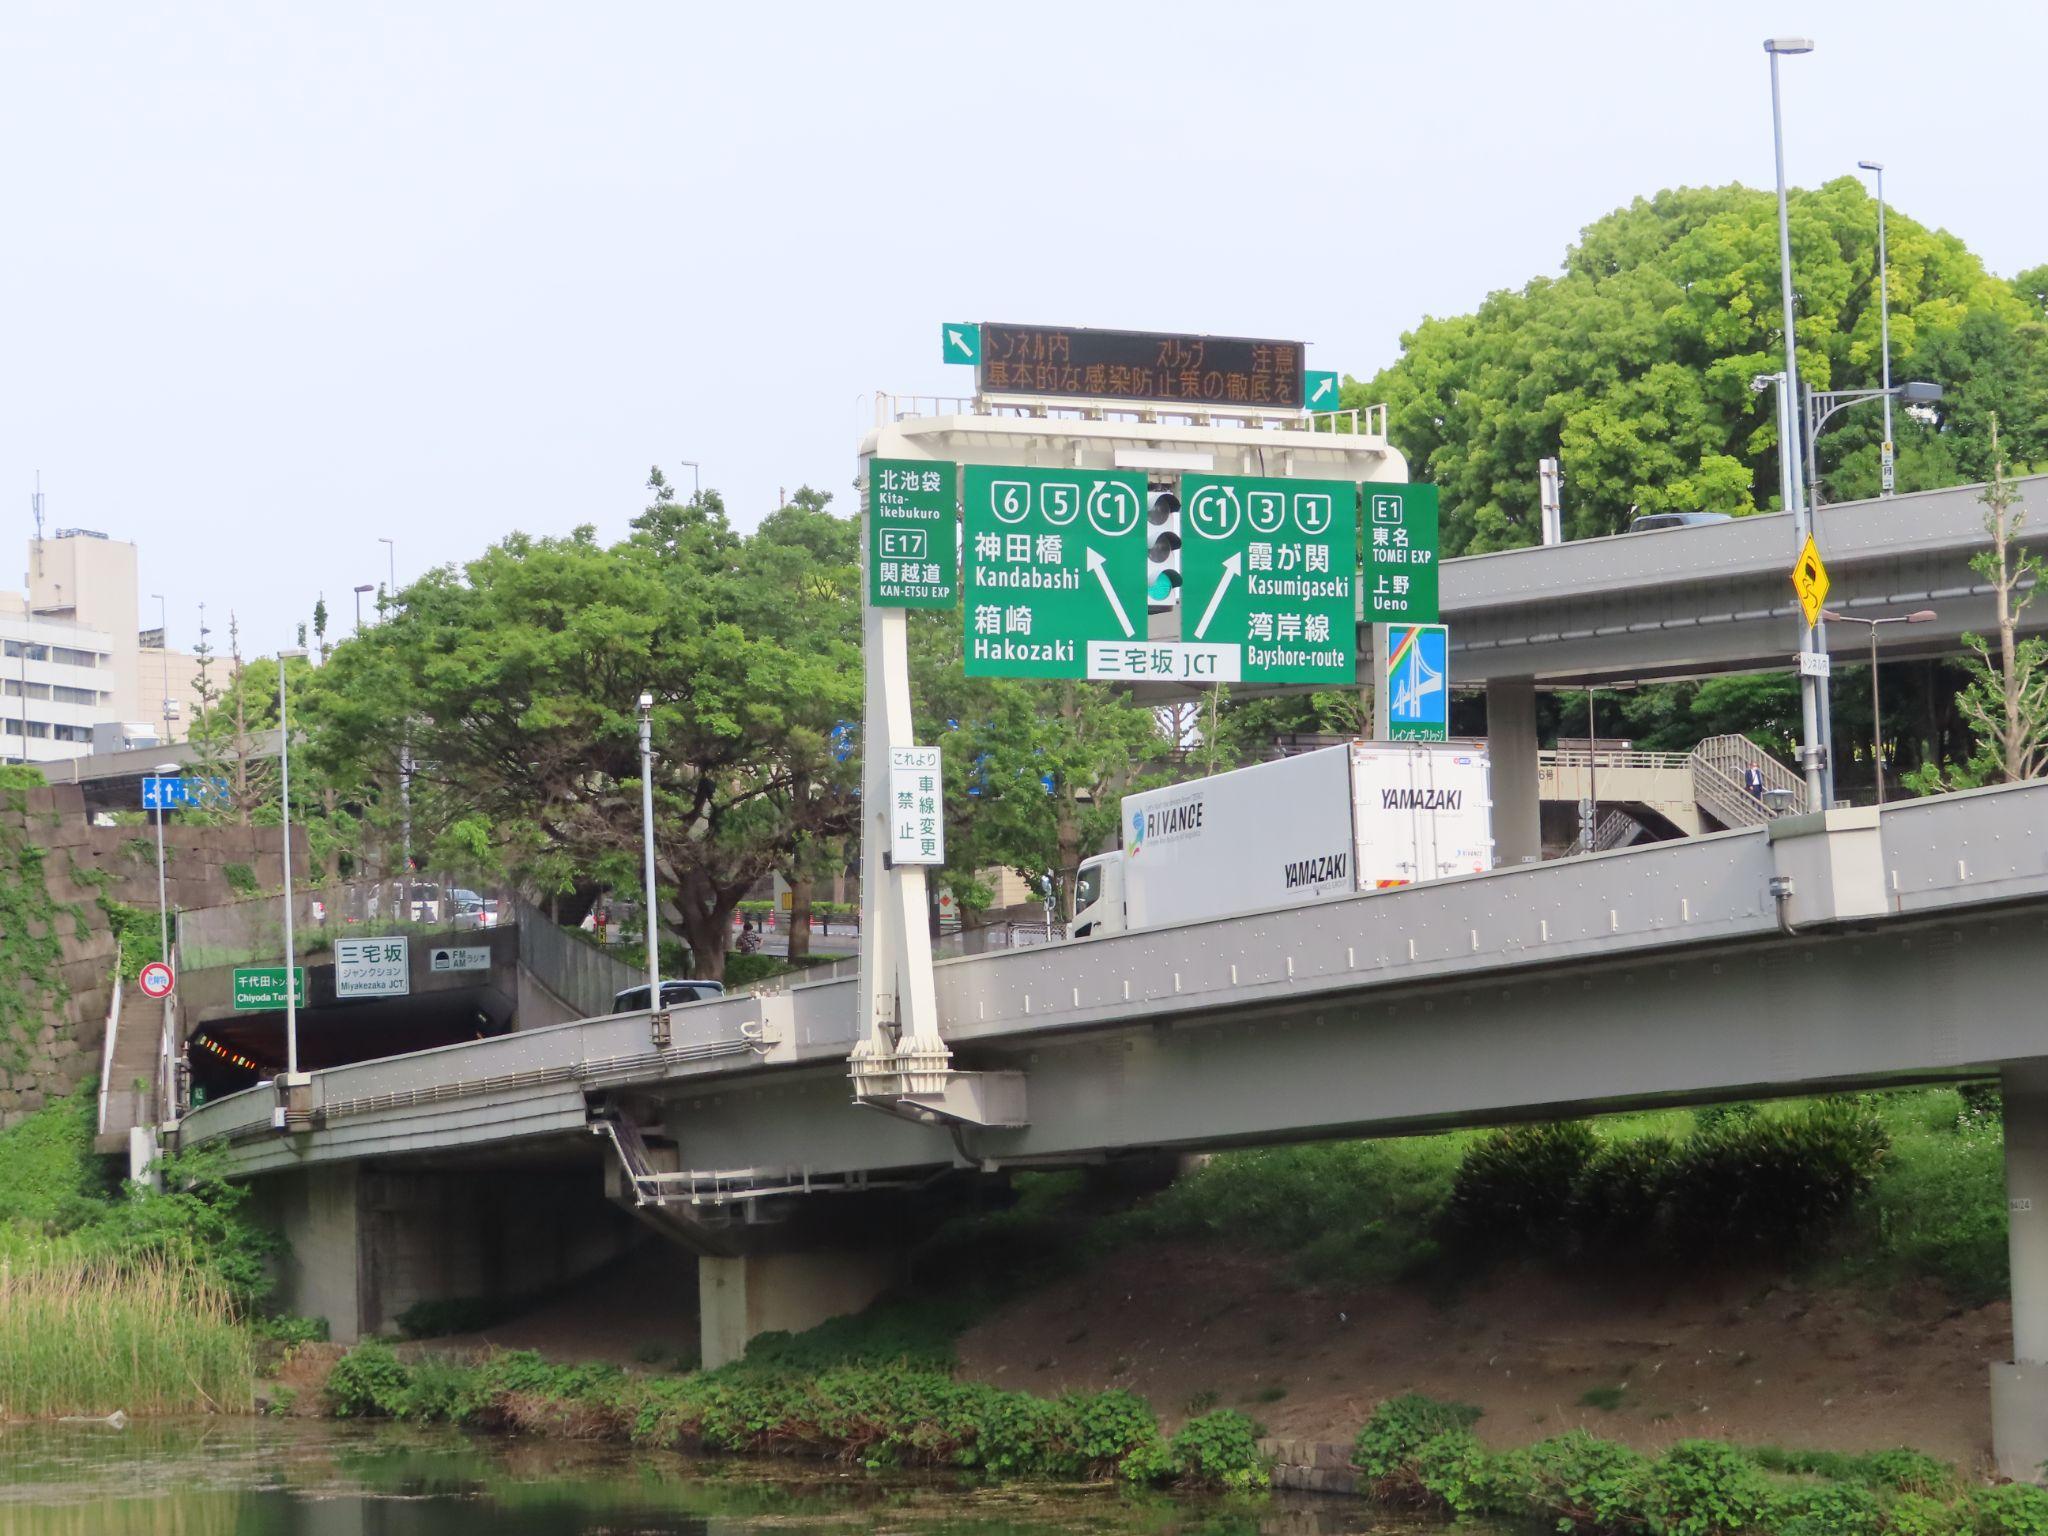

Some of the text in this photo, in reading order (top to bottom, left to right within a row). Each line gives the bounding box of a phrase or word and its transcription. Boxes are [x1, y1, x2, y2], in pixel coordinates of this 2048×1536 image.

[1252, 344, 1295, 374] 注意
[988, 359, 1293, 404] 基本的な感染防止策の徹底を
[879, 470, 941, 493] 北池袋
[879, 493, 909, 505] Kita-
[1003, 488, 1126, 524] 6 5 C1
[1378, 501, 1398, 518] E1
[879, 506, 940, 520] ikebukuro
[1199, 497, 1320, 528] C1 3 1
[884, 534, 923, 553] E17
[974, 532, 1063, 565] 神田橋
[1372, 527, 1409, 548] 東名
[1248, 542, 1329, 573] 霞が関
[1372, 549, 1431, 563] TOMEI EXP
[880, 563, 941, 584] 関越道
[975, 566, 1079, 589] Kandabashi
[880, 586, 950, 598] KAN-ETSU EXP
[1248, 575, 1348, 601] Kasumigaseki
[1373, 576, 1409, 595] 上野
[1374, 597, 1408, 610] Ueno
[974, 604, 1032, 635] 箱崎
[1248, 612, 1330, 643] 湾岸線
[974, 639, 1074, 661] Hakozaki
[1248, 646, 1344, 670] Bayshore-route
[1098, 648, 1217, 678] 三宅坂 JCT
[893, 752, 936, 766] これより
[1382, 788, 1462, 810] YAMAZAKI
[898, 791, 915, 840] 禁止
[918, 776, 936, 856] 車線変更
[1147, 802, 1203, 838] RIVANCE
[1285, 853, 1346, 889] YAMAZAKI
[341, 944, 402, 963] 三宅坂
[343, 968, 400, 978] ジャンクション
[341, 979, 404, 991] Miyakezaka JCT
[237, 992, 301, 1003] Chiyoda Tunel
